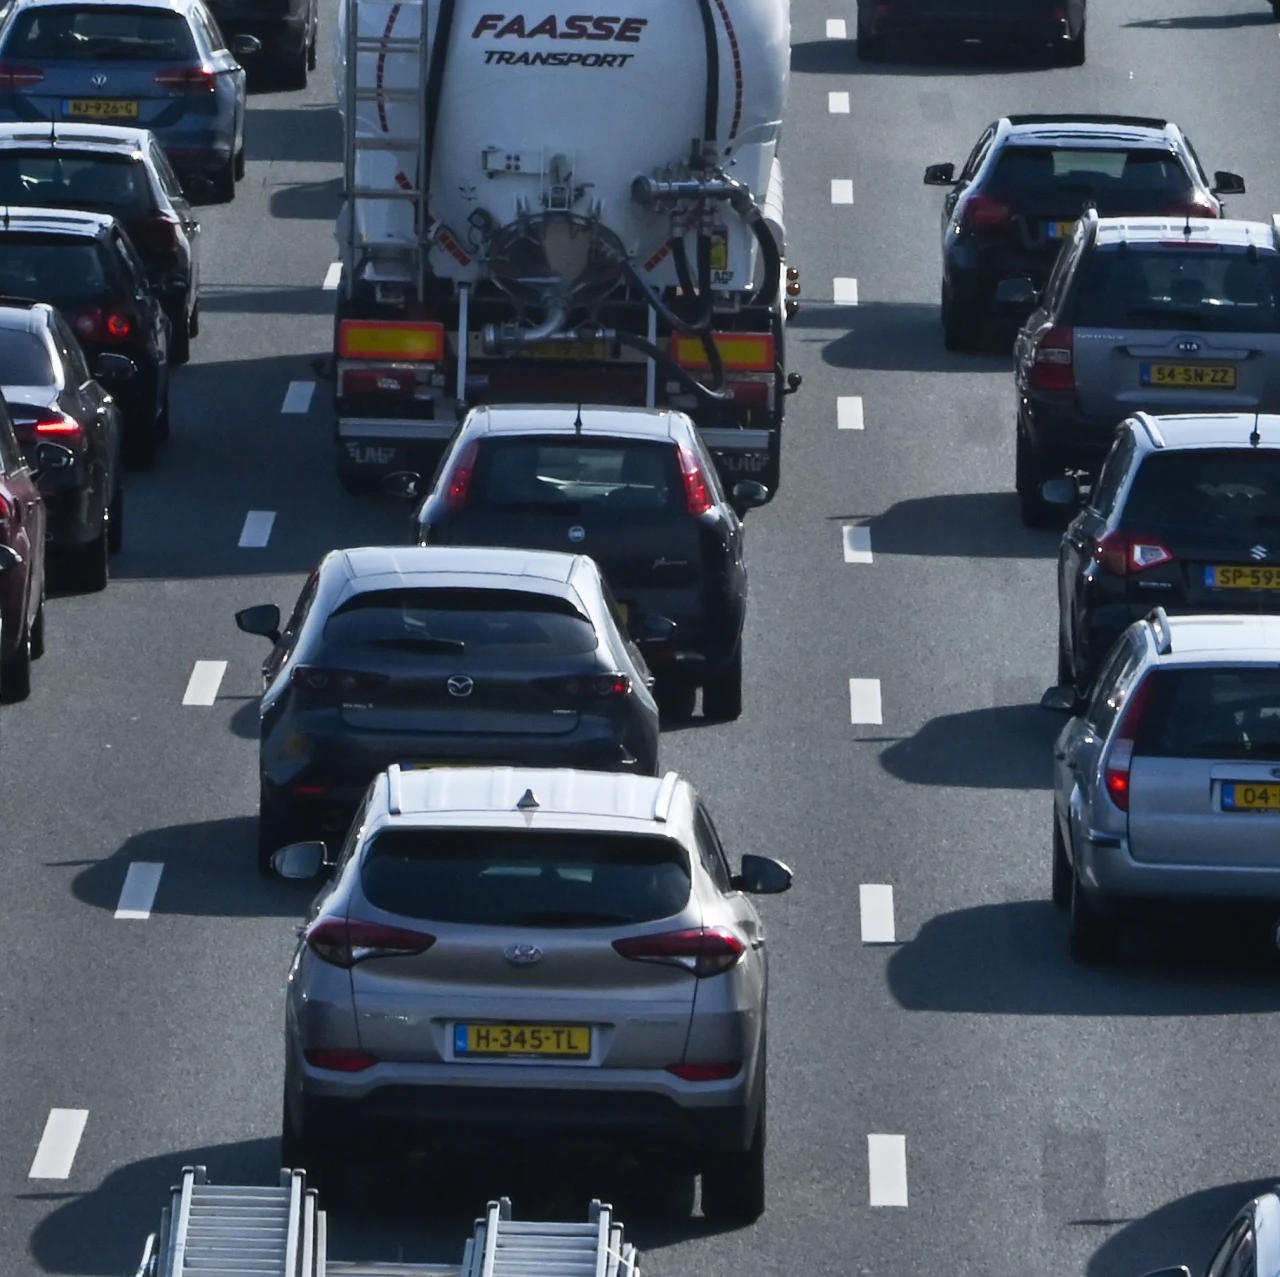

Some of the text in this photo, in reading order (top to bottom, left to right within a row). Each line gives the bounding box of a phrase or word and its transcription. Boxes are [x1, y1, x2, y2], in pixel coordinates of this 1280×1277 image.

[471, 13, 649, 43] FAASSE
[483, 50, 637, 68] TRANSPORT
[1178, 342, 1199, 351] KIA
[1156, 366, 1230, 384] 54-SN-ZZ
[476, 1028, 580, 1051] H-345-TL
